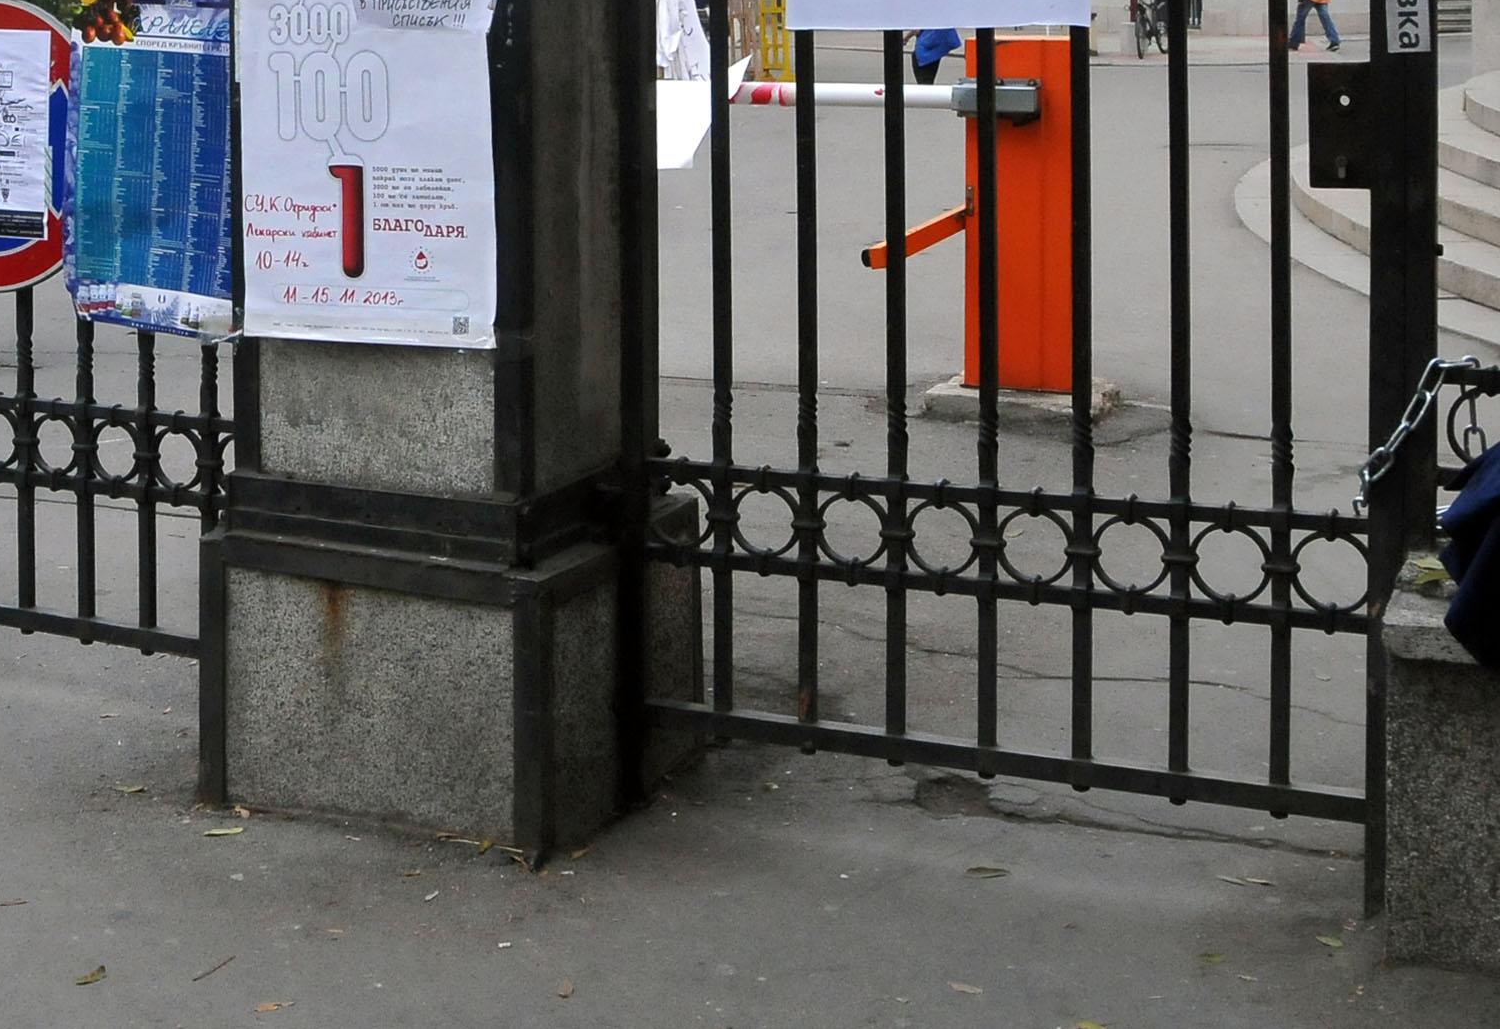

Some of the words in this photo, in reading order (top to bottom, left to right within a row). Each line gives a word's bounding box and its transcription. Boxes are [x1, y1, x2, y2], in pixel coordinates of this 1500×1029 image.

[268, 2, 350, 45] 3000
[391, 13, 449, 28] СПИСЪК
[268, 49, 390, 142] 100
[245, 222, 297, 242] Лекарски
[327, 154, 366, 278] 1
